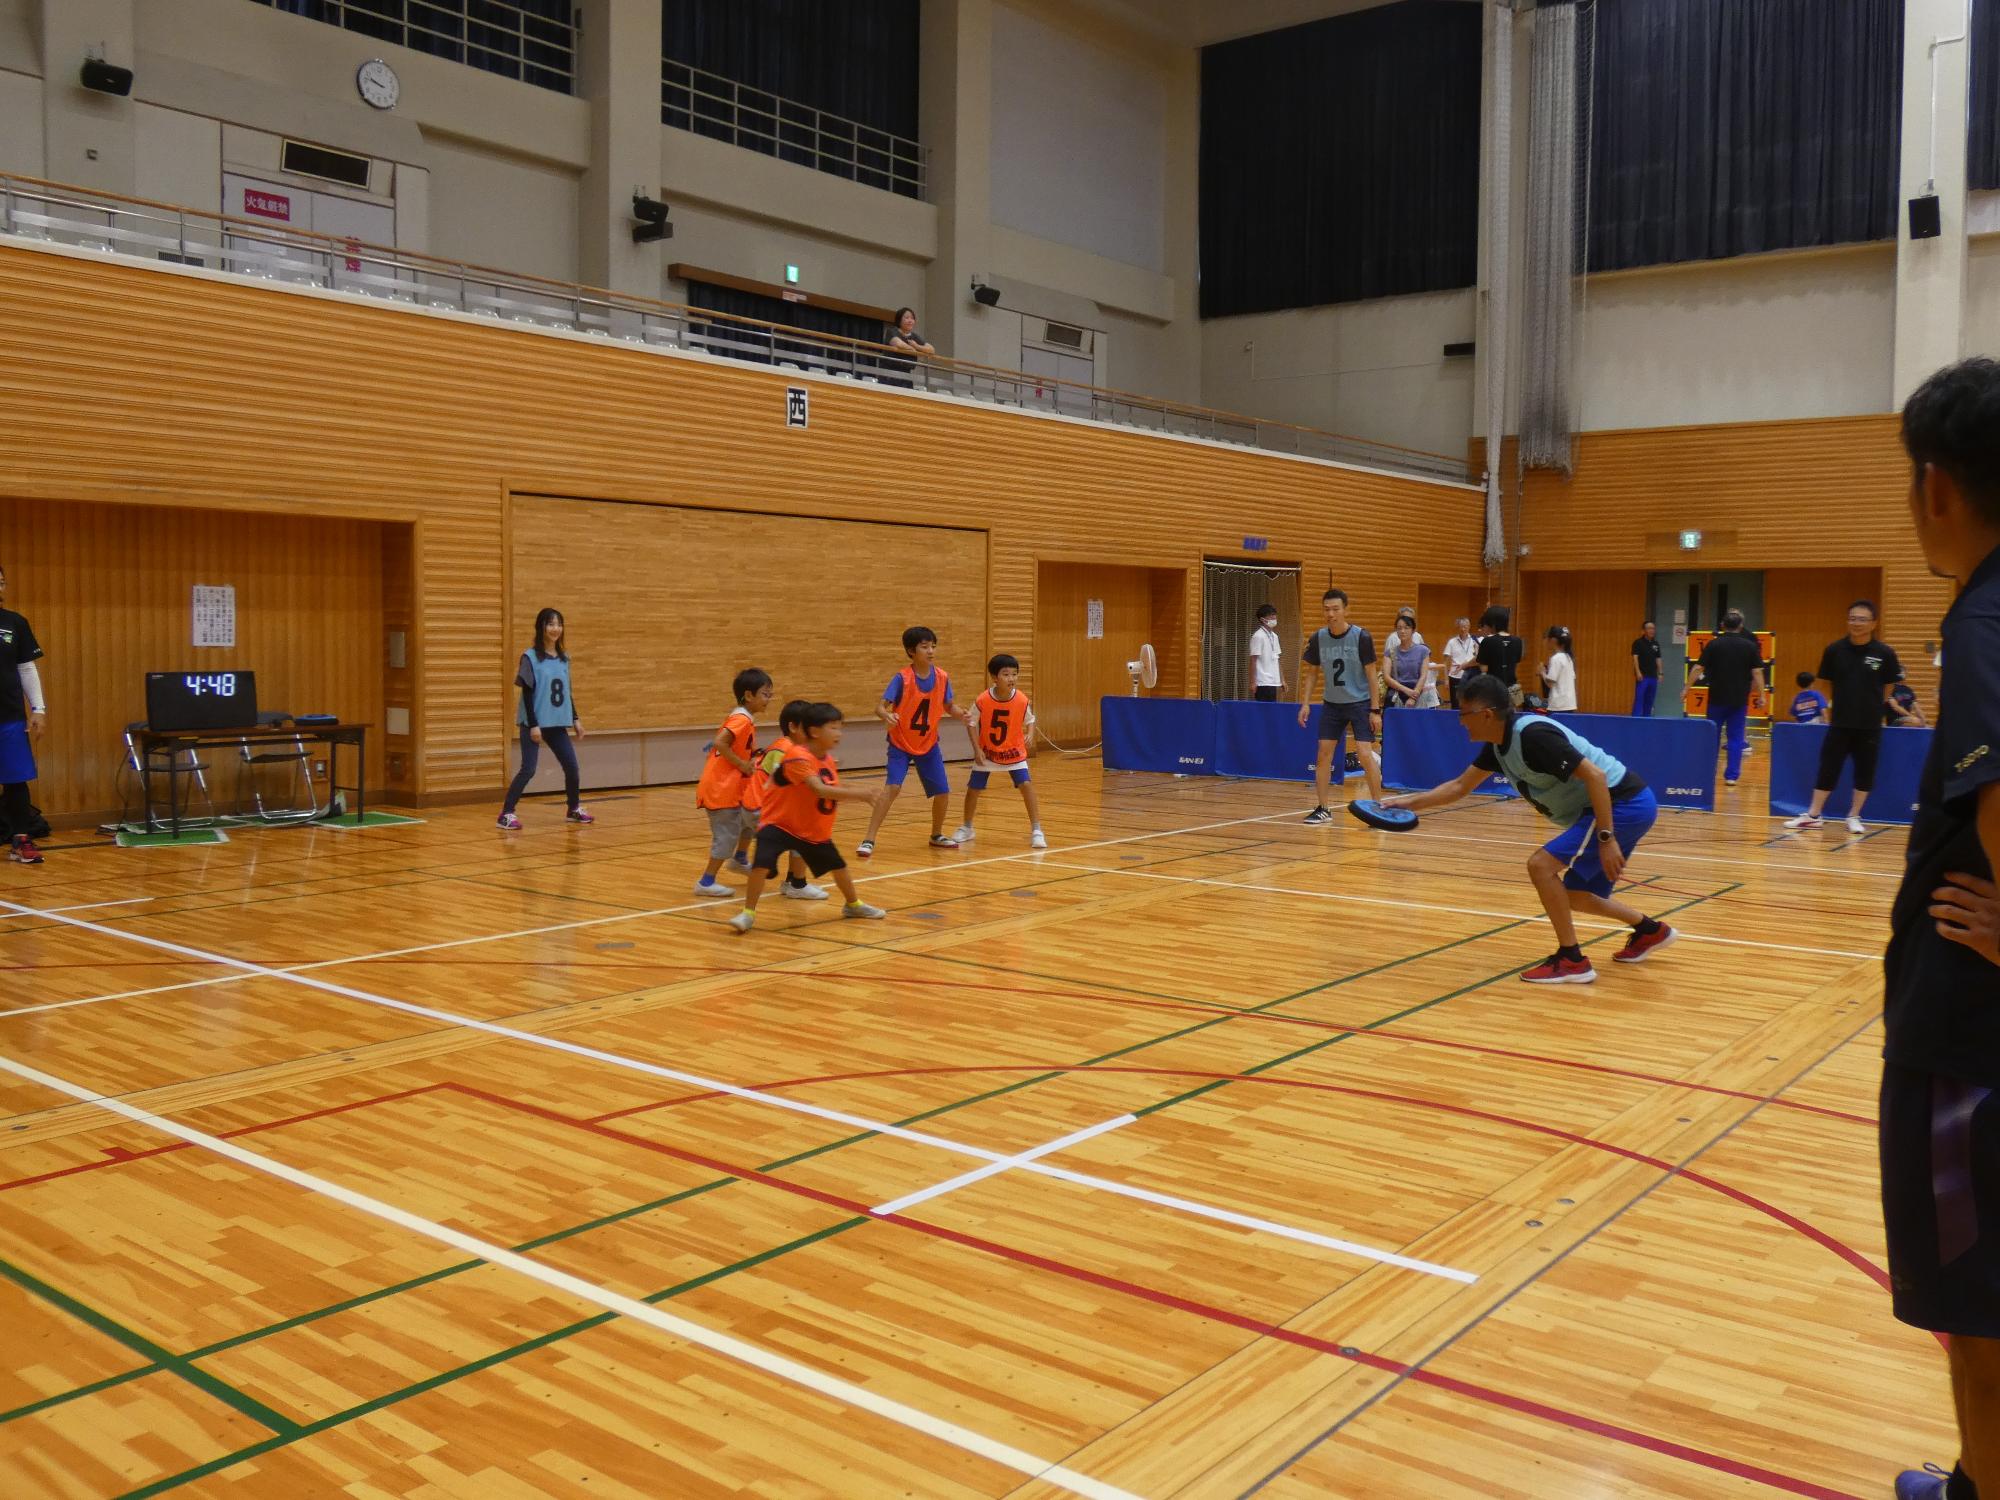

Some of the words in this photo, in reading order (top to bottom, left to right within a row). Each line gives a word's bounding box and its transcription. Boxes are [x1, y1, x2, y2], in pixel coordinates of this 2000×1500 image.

[788, 388, 806, 427] 西
[186, 673, 236, 697] 4:48
[1333, 658, 1346, 687] 2
[550, 678, 564, 708] 8
[1696, 696, 1704, 708] 7
[909, 698, 931, 737] 4
[989, 709, 1010, 747] 5
